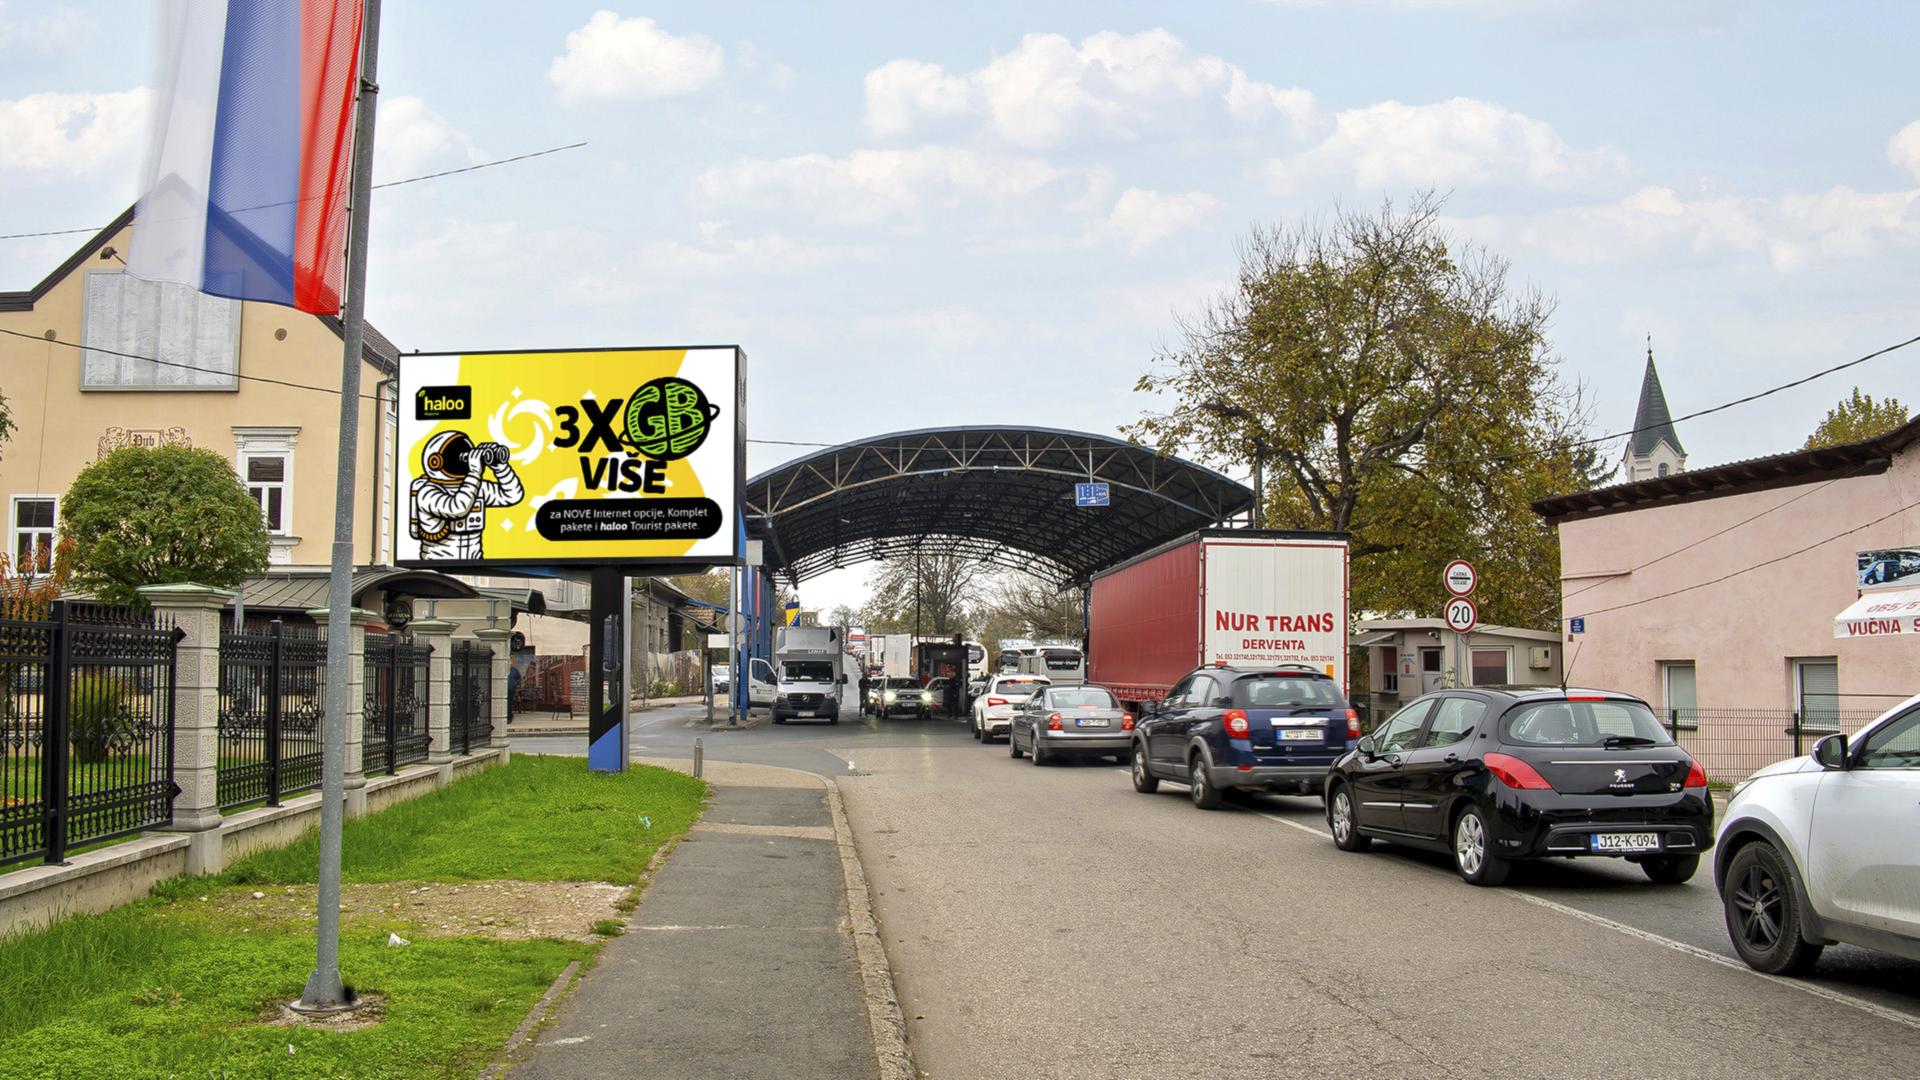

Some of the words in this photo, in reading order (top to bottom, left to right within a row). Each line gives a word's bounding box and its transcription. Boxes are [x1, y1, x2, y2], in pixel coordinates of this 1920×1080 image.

[424, 396, 465, 411] haloo
[627, 382, 705, 455] GB
[579, 452, 667, 494] VIŠE
[550, 511, 561, 519] za
[563, 509, 591, 519] NOVE
[593, 508, 631, 518] Internet
[633, 507, 665, 519] opcije,
[667, 507, 708, 518] Komplet
[560, 523, 593, 533] pakete
[600, 521, 628, 531] haloo
[630, 521, 662, 531] Tourist
[664, 520, 699, 531] pakete.
[1216, 610, 1259, 631] NUR
[1265, 612, 1334, 633] TRANS
[1452, 605, 1470, 624] 20
[1847, 617, 1901, 636] VUČNA
[1242, 639, 1305, 650] DERVENTA
[1600, 834, 1657, 848] J12-K-094
